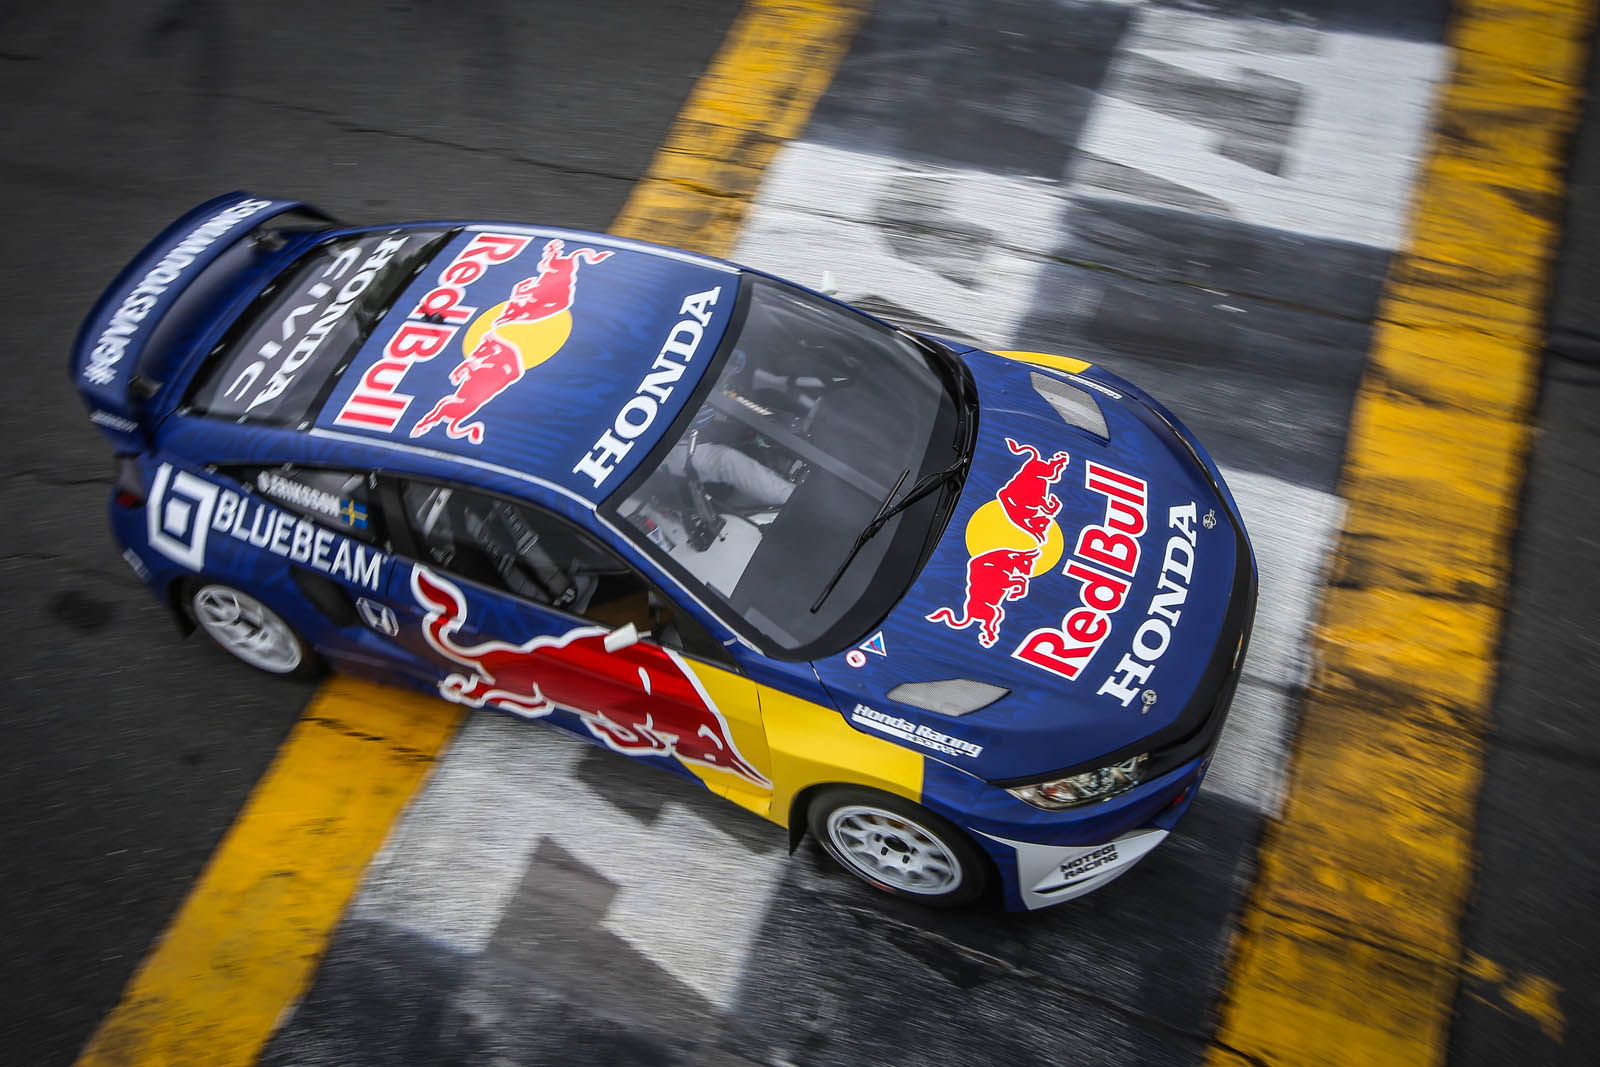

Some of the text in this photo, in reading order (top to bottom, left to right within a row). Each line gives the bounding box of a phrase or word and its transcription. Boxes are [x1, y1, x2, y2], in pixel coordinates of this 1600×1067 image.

[224, 247, 362, 402] CIVIC
[245, 235, 410, 413] HONDA
[572, 286, 722, 489] HONDA
[211, 489, 382, 591] BLUEBEAM
[1096, 500, 1198, 707] HONDA
[853, 703, 917, 734] Honda
[914, 724, 984, 758] Racing
[1061, 844, 1115, 872] MOTEGI
[1063, 851, 1119, 880] RACING
